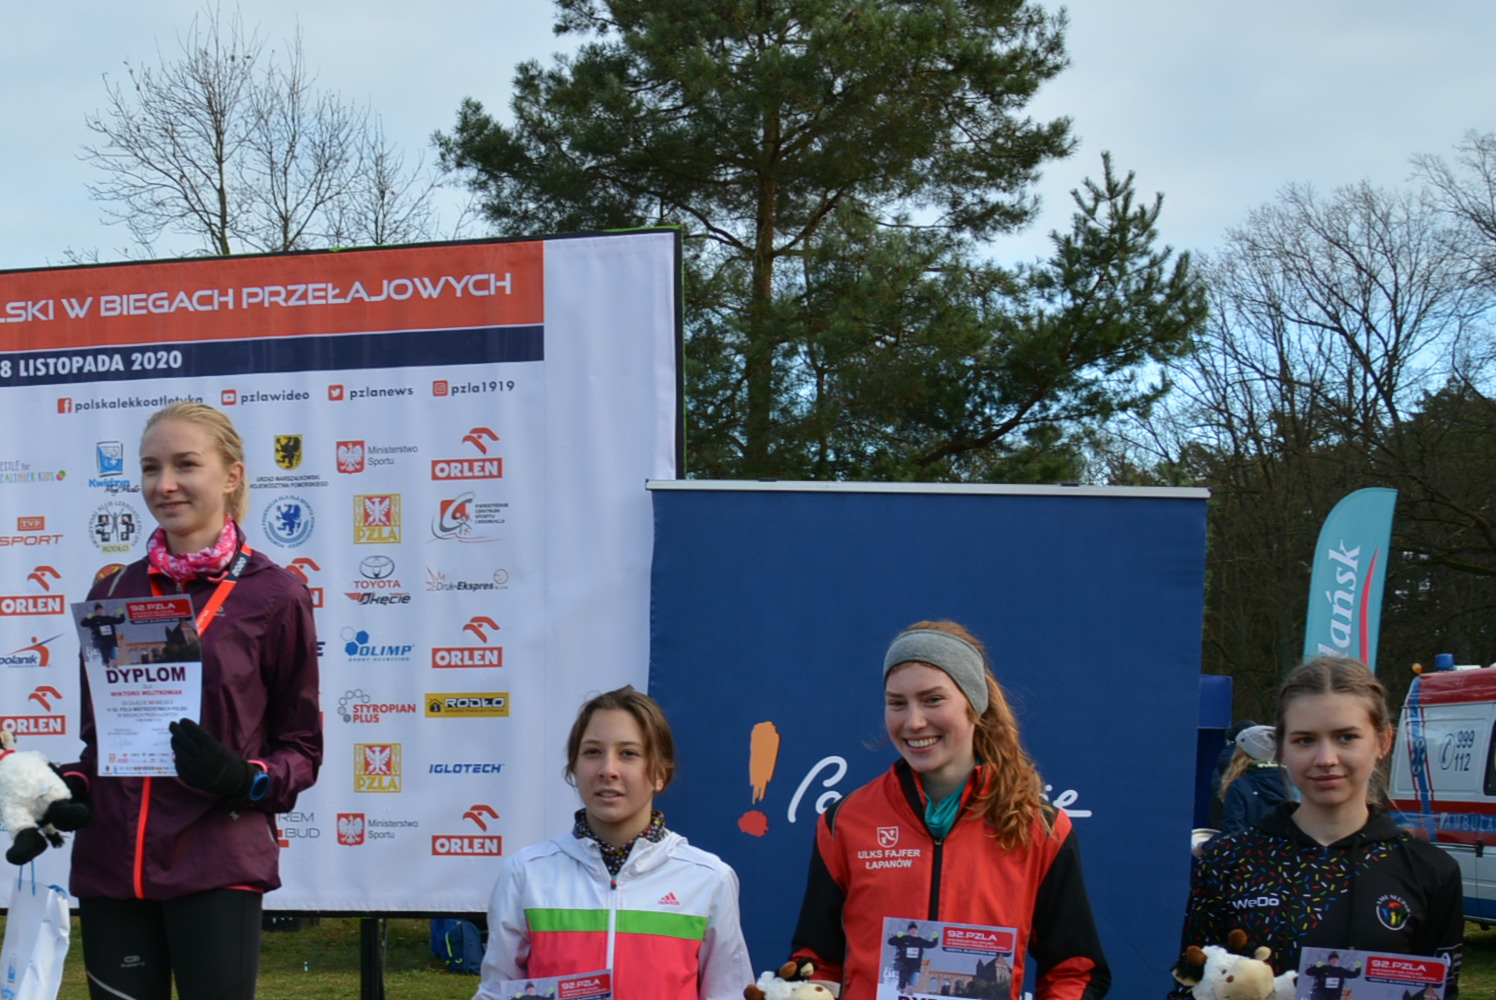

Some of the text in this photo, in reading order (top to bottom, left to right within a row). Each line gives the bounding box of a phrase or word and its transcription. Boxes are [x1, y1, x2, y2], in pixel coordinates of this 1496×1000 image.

[60, 297, 93, 319] W
[100, 289, 234, 317] BIEGACH
[242, 273, 512, 309] PRZEŁAJOWYCH
[19, 353, 125, 377] LISTOPADA
[130, 350, 183, 371] 2020
[349, 385, 414, 401] pzlanews
[451, 380, 515, 396] pzla1919
[241, 390, 310, 405] pzlawideo
[367, 445, 418, 454] Ministerstwo
[367, 457, 395, 467] Sportu
[435, 461, 499, 477] ORLEN
[356, 527, 398, 541] PZLA
[353, 580, 402, 589] TOYOTA
[0, 598, 60, 613] ORLEN
[359, 645, 412, 656] OLIMP
[435, 650, 499, 666] ORLEN
[106, 666, 186, 684] DYPLOM
[353, 703, 416, 714] STYROPIAN
[445, 697, 505, 708] RODŁO
[2, 718, 62, 733] ORLEN
[353, 714, 380, 723] PLUS
[1456, 730, 1475, 749] 999
[429, 764, 502, 774] IGLOTECH
[1454, 753, 1471, 772] 112
[357, 776, 398, 790] PZLA
[368, 819, 419, 828] Ministerstwo
[285, 827, 321, 839] BUD
[368, 830, 395, 840] Sportu
[435, 838, 499, 854] ORLEN
[858, 848, 921, 859] ULKS FAJFER
[865, 859, 913, 869] ŁAPANÓW
